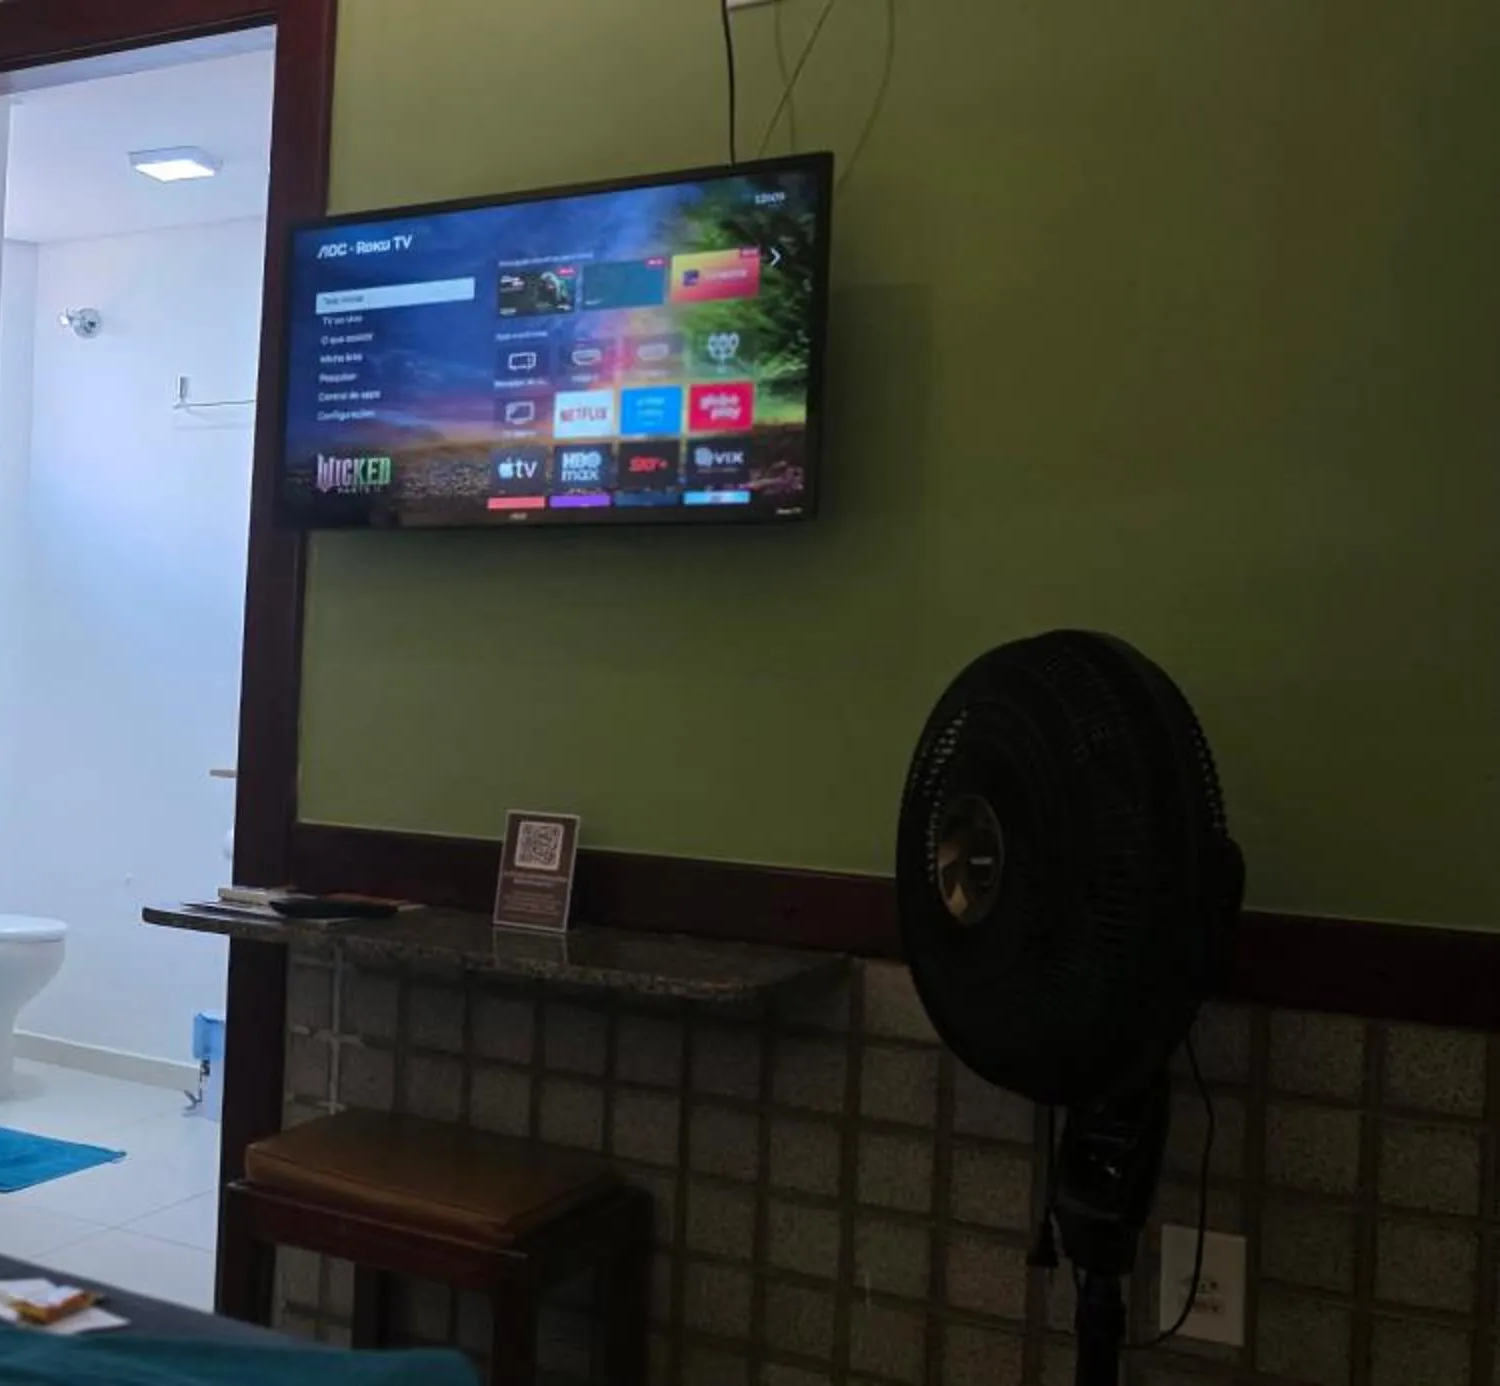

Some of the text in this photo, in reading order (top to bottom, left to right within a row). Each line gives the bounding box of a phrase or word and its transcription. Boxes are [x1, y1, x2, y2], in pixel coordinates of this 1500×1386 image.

[393, 234, 413, 249] TV
[562, 406, 608, 423] NETFLIX
[562, 451, 602, 469] HBO
[317, 454, 392, 493] WICKED
[515, 459, 538, 479] tv
[562, 468, 600, 481] max
